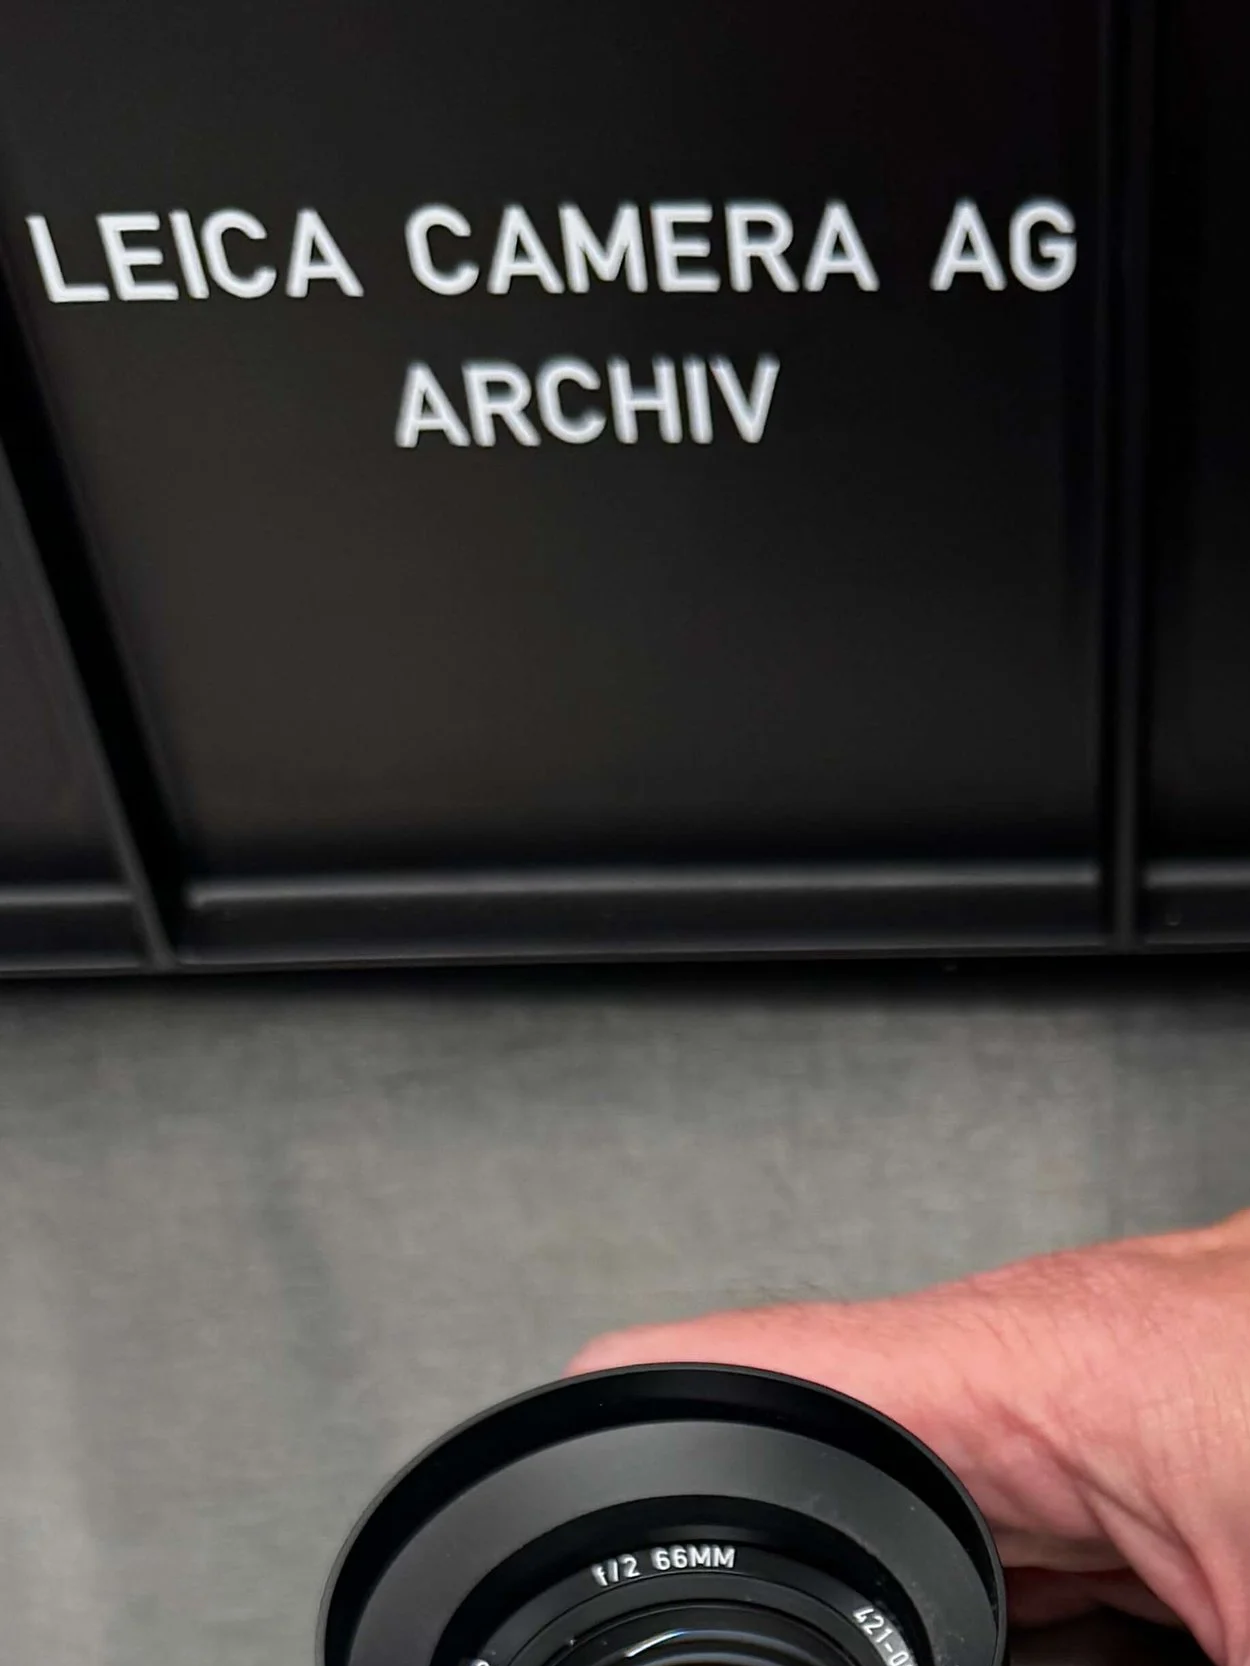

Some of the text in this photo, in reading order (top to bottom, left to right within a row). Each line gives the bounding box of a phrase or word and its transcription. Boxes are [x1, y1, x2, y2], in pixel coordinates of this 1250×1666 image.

[26, 199, 1079, 304] LEICA CAMERA AG
[394, 355, 780, 448] ARCHIV
[591, 1544, 735, 1587] f/2 66MM
